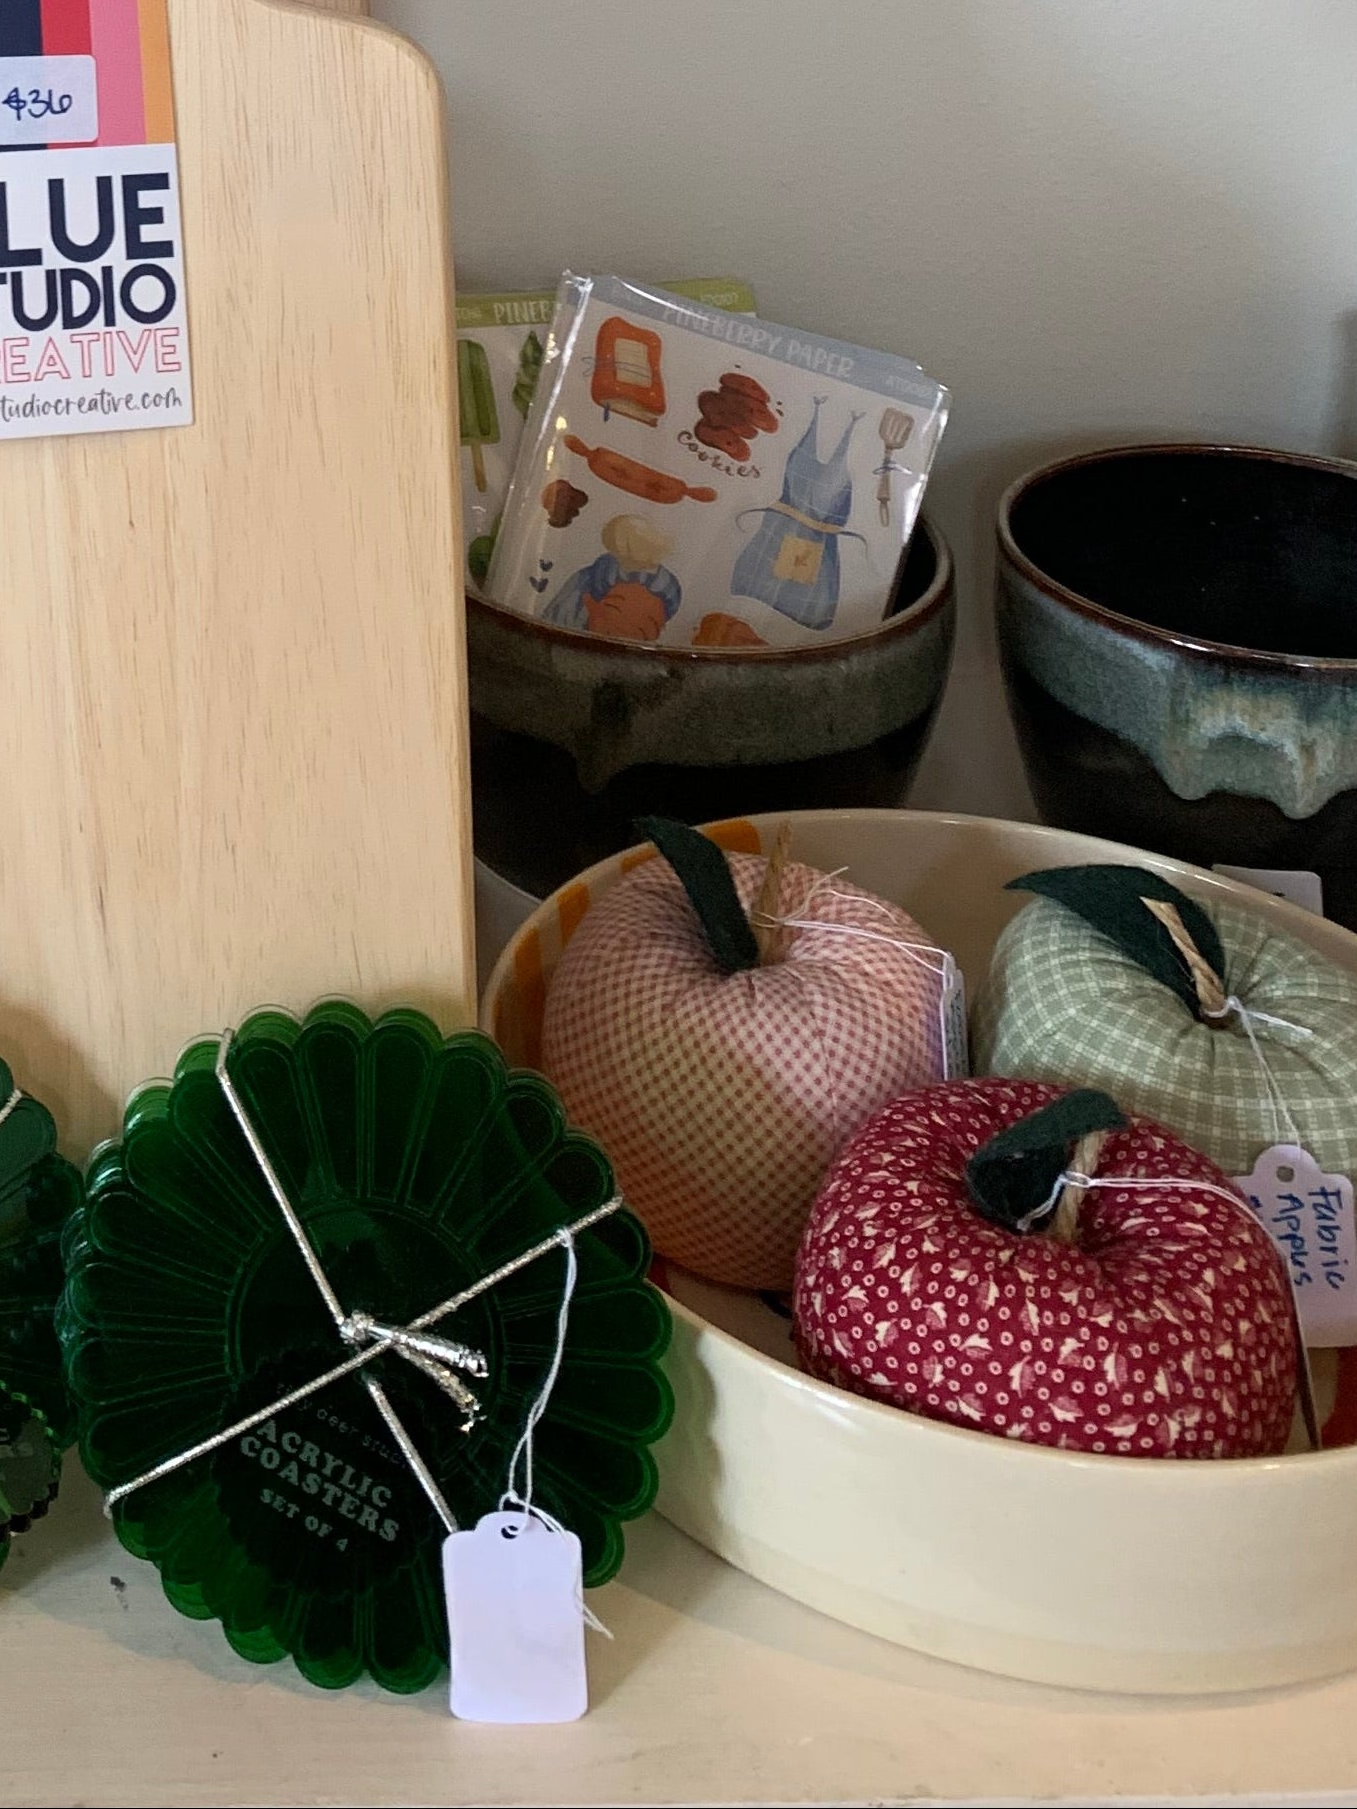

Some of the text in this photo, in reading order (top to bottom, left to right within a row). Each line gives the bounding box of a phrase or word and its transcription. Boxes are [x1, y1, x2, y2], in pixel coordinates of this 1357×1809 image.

[2, 87, 73, 121] $36
[786, 340, 855, 379] PAPER
[1307, 1186, 1349, 1290] Fabric
[239, 1435, 400, 1542] COASTERS
[256, 1419, 392, 1508] ACRYLIC
[259, 1488, 349, 1552] SET OF 4
